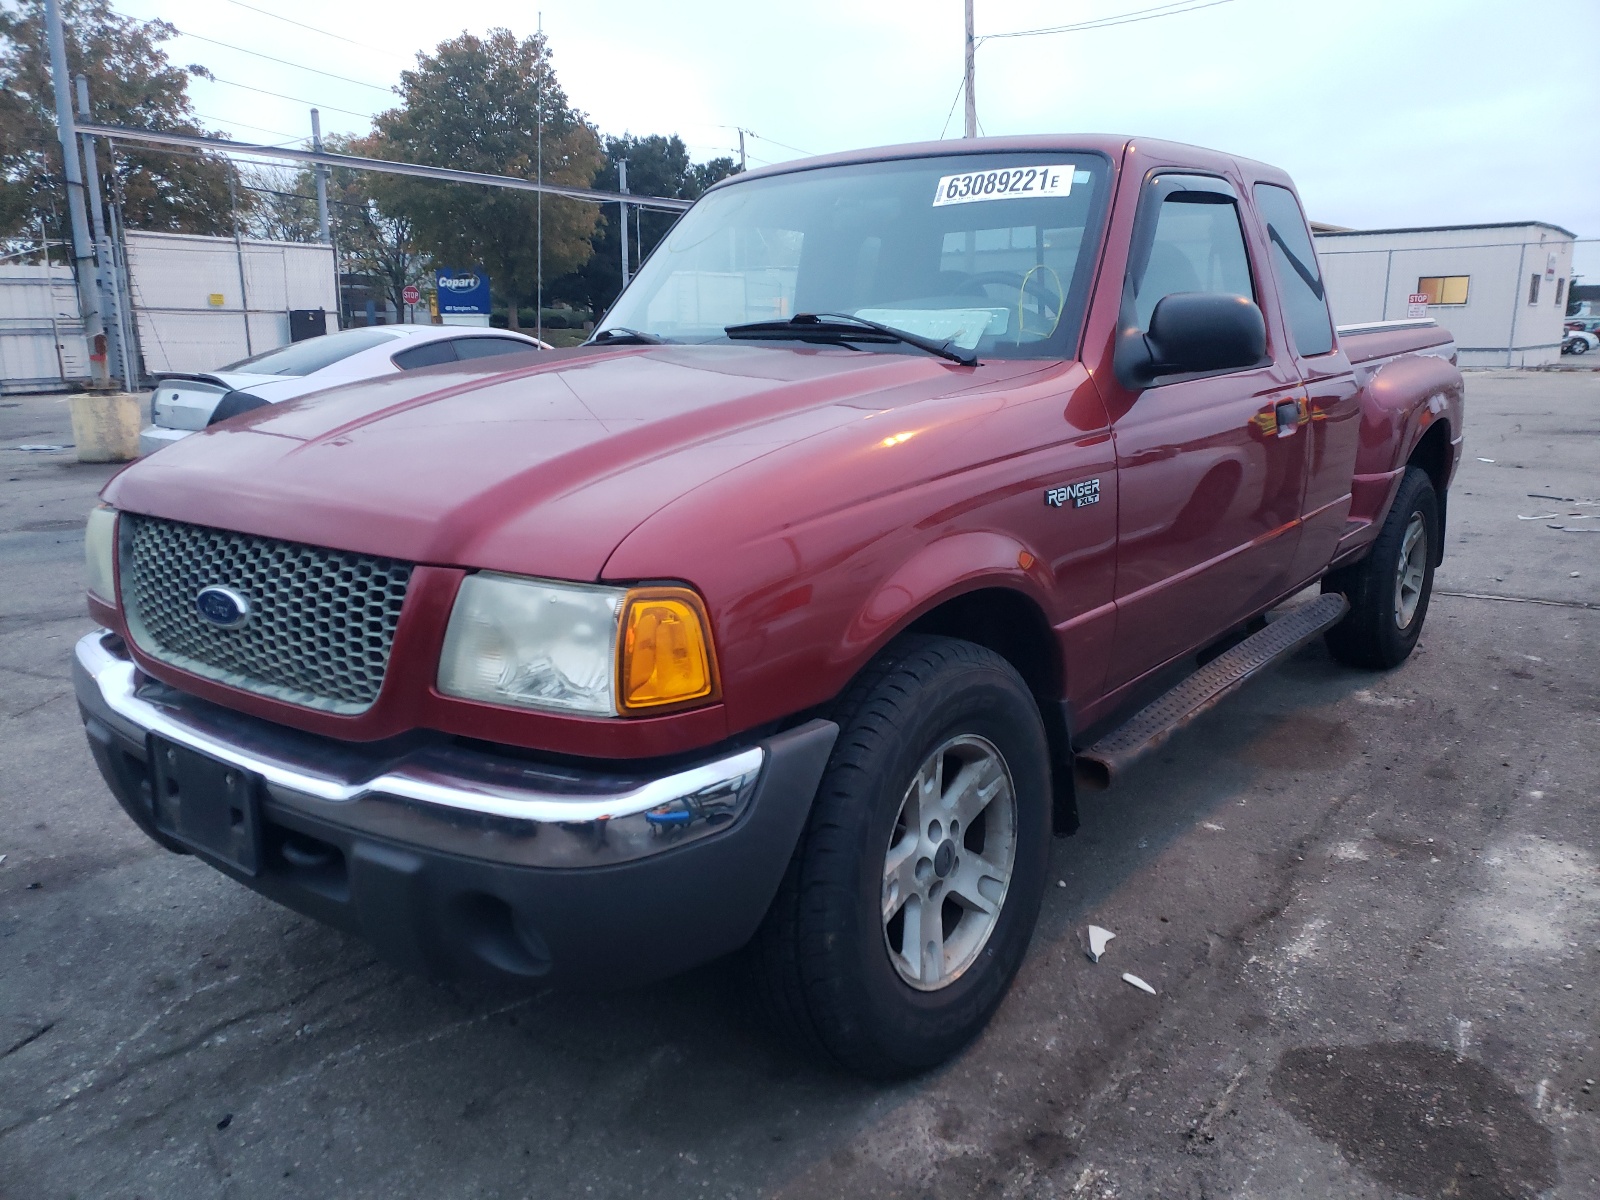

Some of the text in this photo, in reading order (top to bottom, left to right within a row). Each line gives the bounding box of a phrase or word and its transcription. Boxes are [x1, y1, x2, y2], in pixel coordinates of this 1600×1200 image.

[946, 168, 1060, 199] 63089221 E
[438, 277, 475, 289] Copart
[403, 291, 419, 299] STOP
[1409, 295, 1428, 303] STOP
[1047, 478, 1100, 507] RANGER
[1079, 493, 1099, 507] XLT
